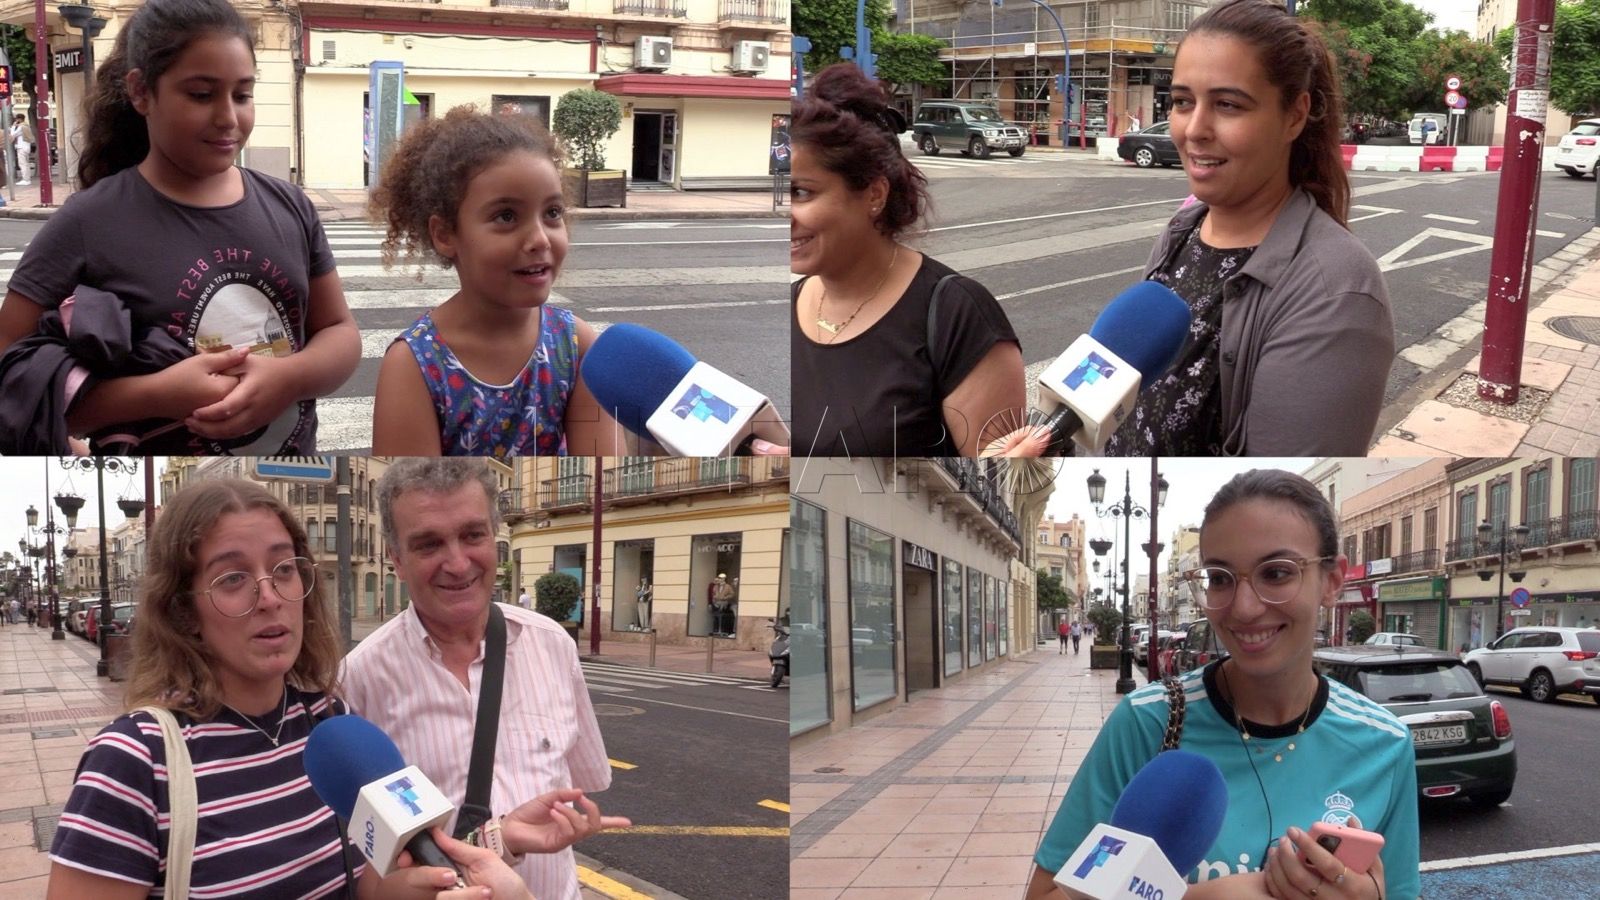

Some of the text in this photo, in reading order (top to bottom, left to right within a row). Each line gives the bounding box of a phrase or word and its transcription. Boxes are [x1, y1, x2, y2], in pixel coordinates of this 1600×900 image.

[911, 544, 933, 570] ZARA
[1413, 728, 1440, 742] 2842
[1442, 726, 1463, 740] KSG
[364, 820, 375, 860] FARO
[1128, 875, 1165, 900] FARO
